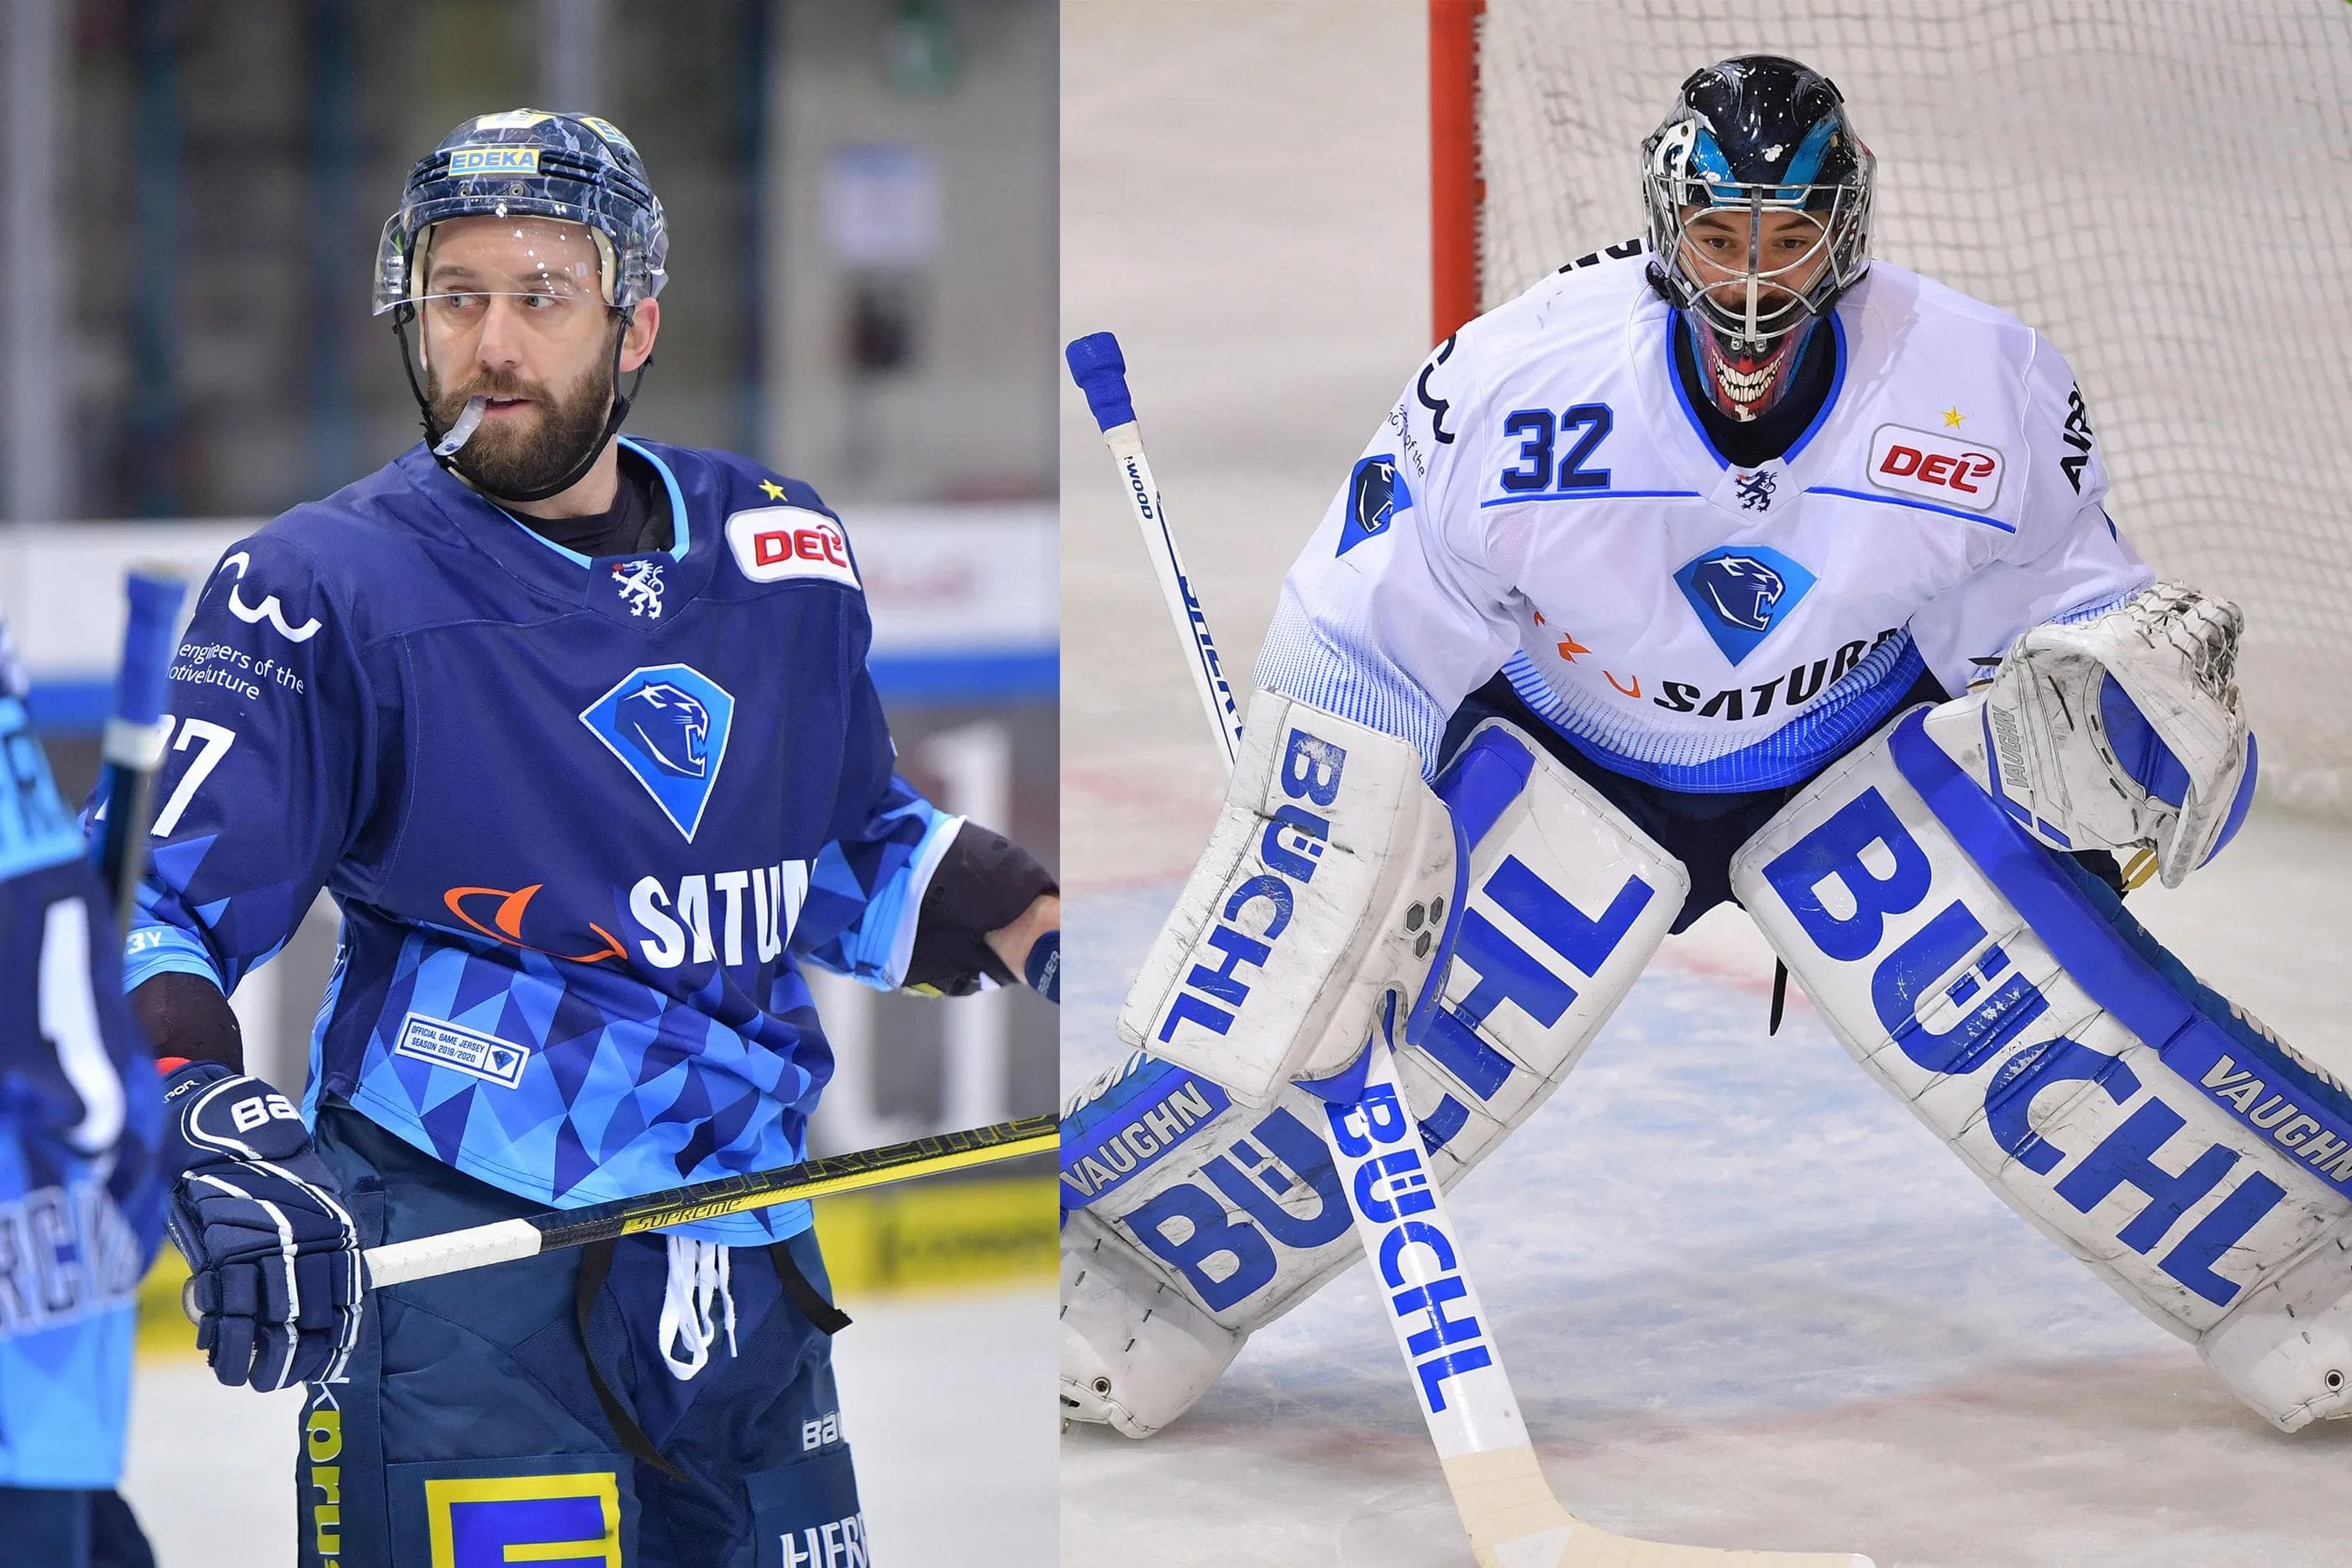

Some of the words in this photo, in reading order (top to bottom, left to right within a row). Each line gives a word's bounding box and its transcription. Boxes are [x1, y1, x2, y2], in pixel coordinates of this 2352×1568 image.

[451, 152, 536, 168] EDEKA
[1500, 401, 1614, 493] 32
[1880, 445, 1982, 494] DEL
[754, 528, 847, 568] DEL
[255, 659, 275, 677] of
[276, 666, 304, 695] the
[1992, 705, 2029, 789] VAUGHN
[1159, 728, 1347, 1045] BÜCHL
[411, 1025, 436, 1040] OFFICIAL
[438, 1033, 458, 1046] GAME
[459, 1039, 486, 1053] JERSEY
[411, 1037, 437, 1051] SEASON
[438, 1045, 476, 1062] 2019/2020
[1761, 785, 2288, 1308] BÜCHL
[1060, 1080, 1214, 1197] VAUGHN
[1324, 1083, 1493, 1413] BÜCHL
